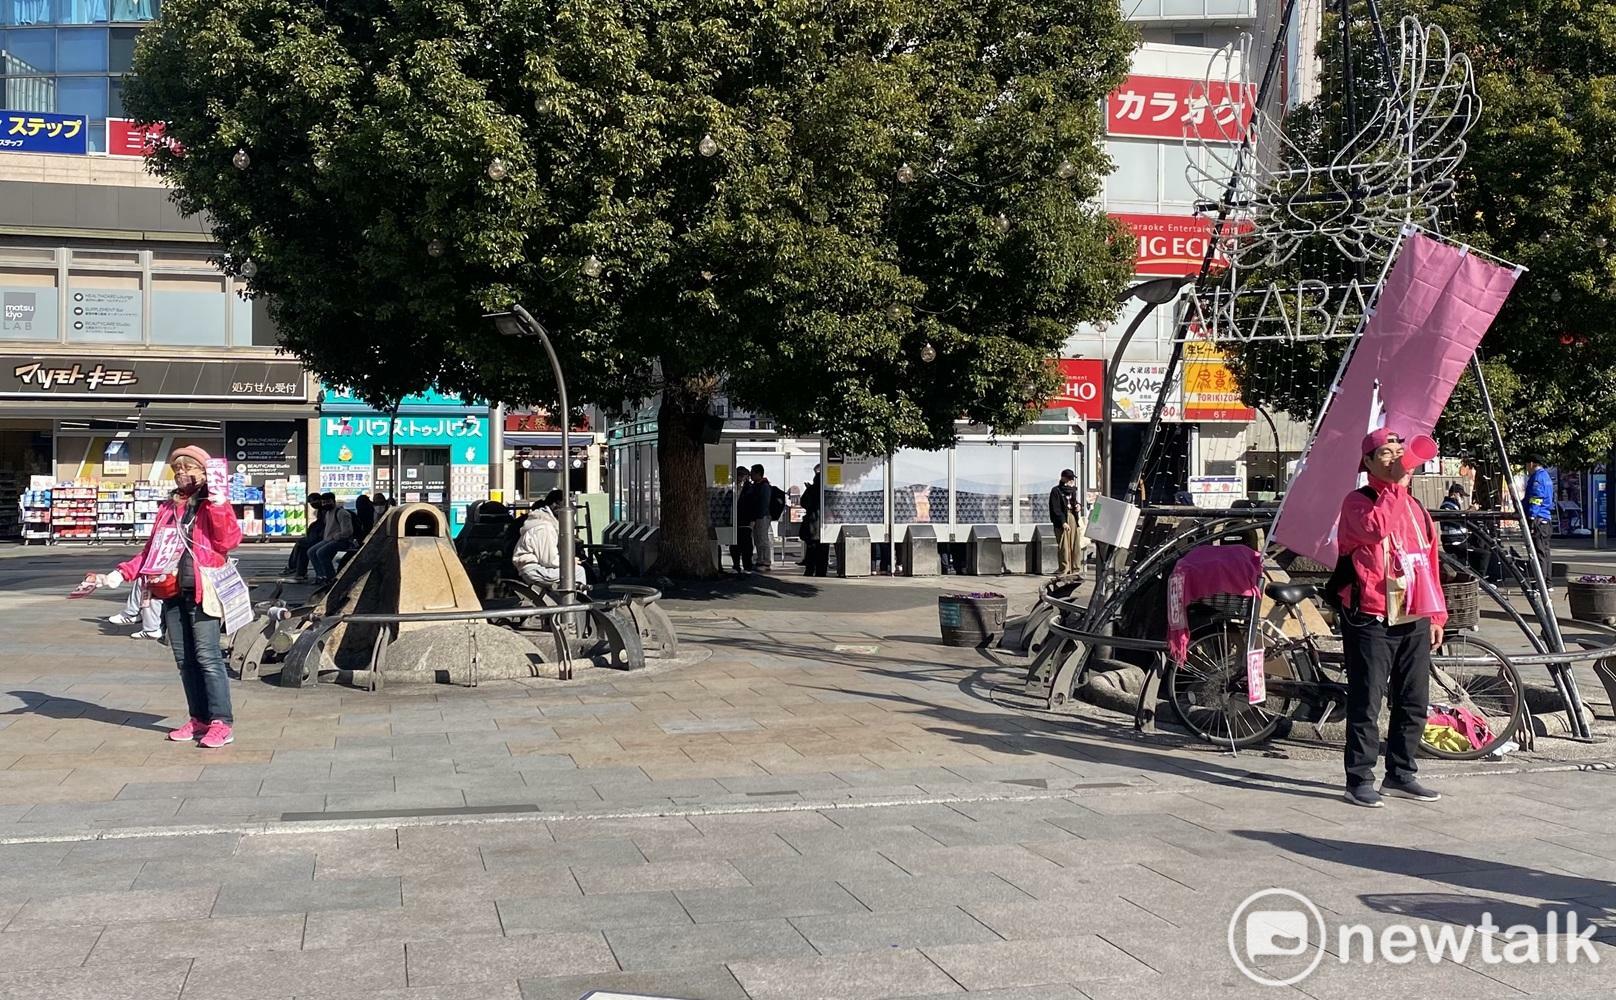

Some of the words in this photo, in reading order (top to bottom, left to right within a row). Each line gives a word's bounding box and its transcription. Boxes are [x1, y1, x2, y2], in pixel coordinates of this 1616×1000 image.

[1115, 91, 1245, 126] カラオケ
[8, 116, 83, 138] ステップ
[1141, 236, 1167, 258] IG
[5, 304, 35, 312] matsu
[5, 312, 23, 321] kiyo
[3, 321, 32, 331] LAB
[14, 362, 138, 390] マツモトキヨシ
[232, 382, 297, 394] 処方せん受付
